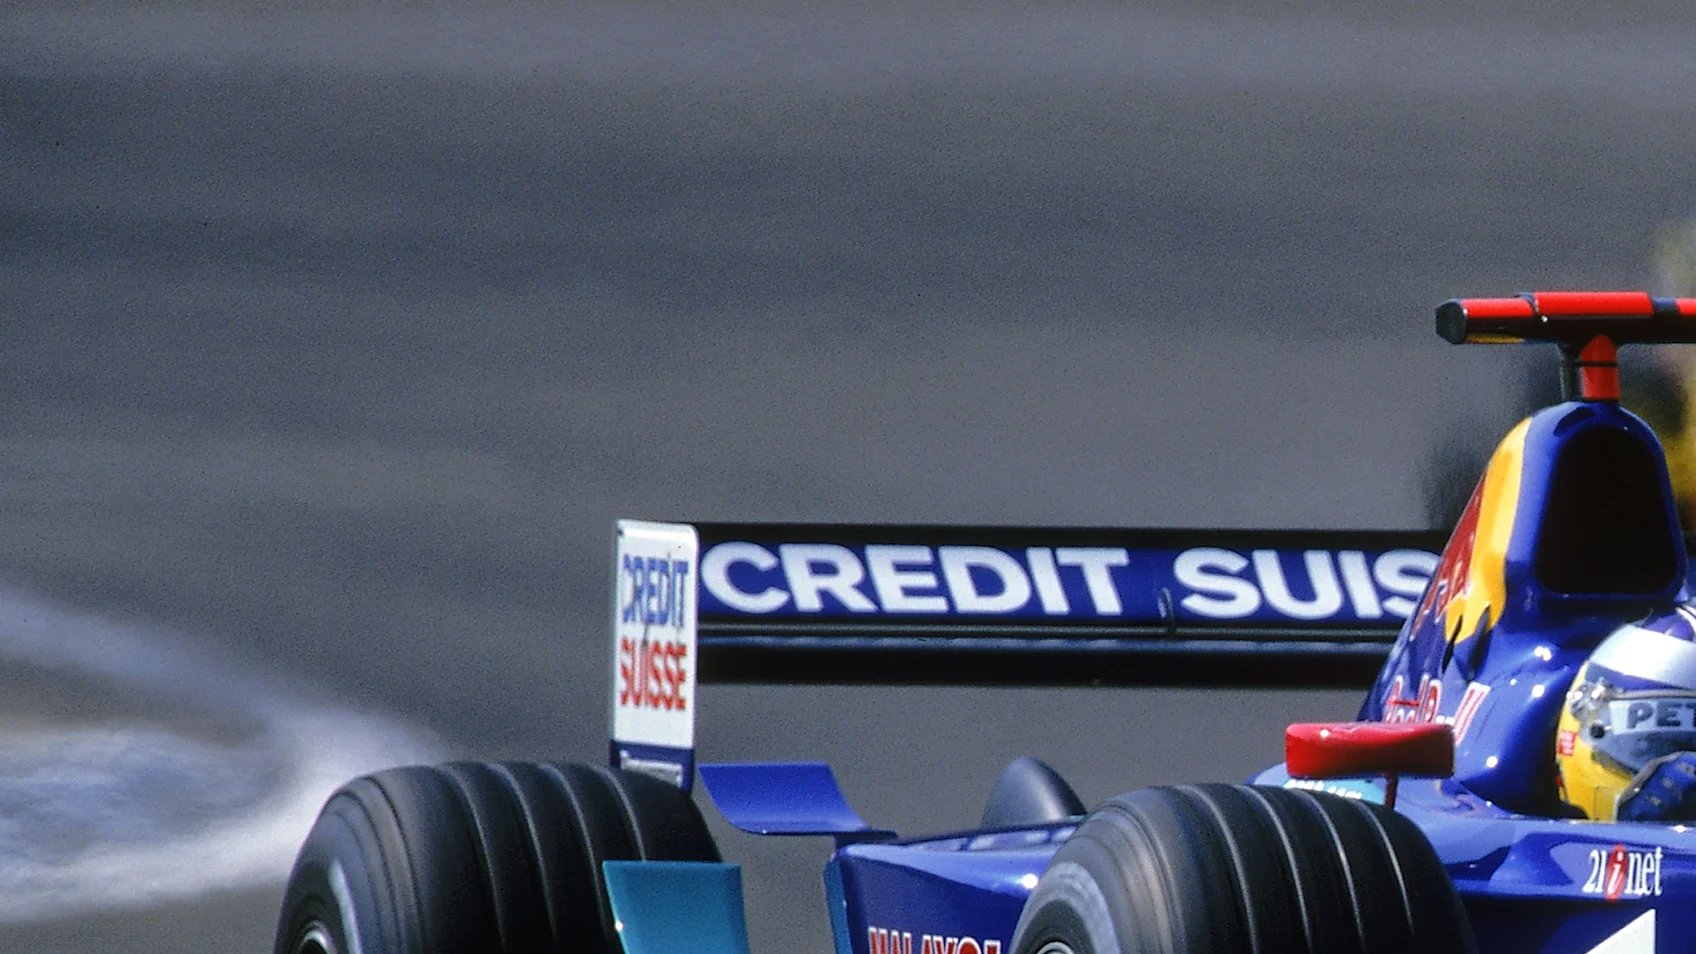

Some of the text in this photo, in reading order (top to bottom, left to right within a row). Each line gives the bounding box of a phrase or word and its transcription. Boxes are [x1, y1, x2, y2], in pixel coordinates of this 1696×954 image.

[622, 553, 689, 627] CREDIT
[700, 541, 1129, 616] CREDIT
[620, 636, 688, 711] SUISSE
